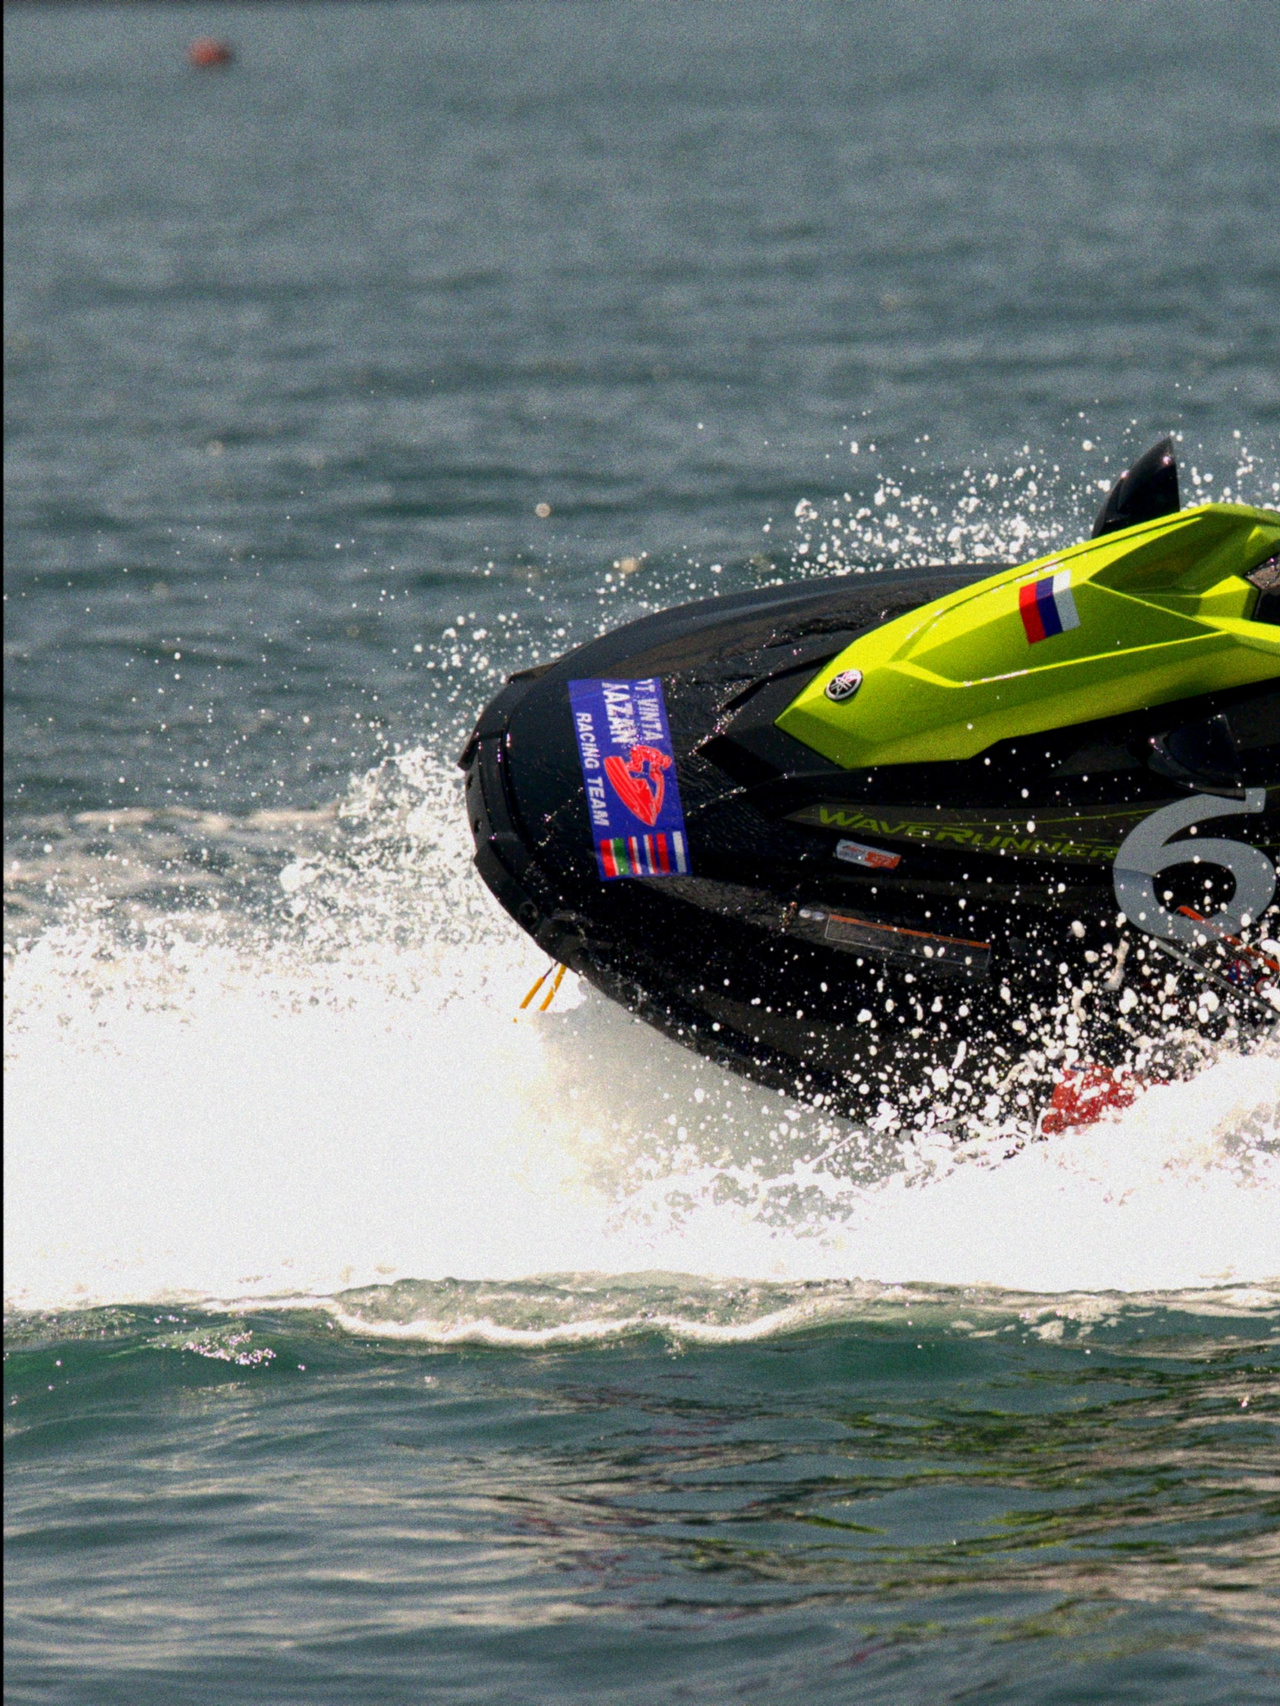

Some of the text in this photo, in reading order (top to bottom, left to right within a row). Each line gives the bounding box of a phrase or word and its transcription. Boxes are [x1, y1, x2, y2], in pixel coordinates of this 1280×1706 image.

[636, 698, 665, 741] VINTA
[576, 712, 610, 826] RACING TEAM
